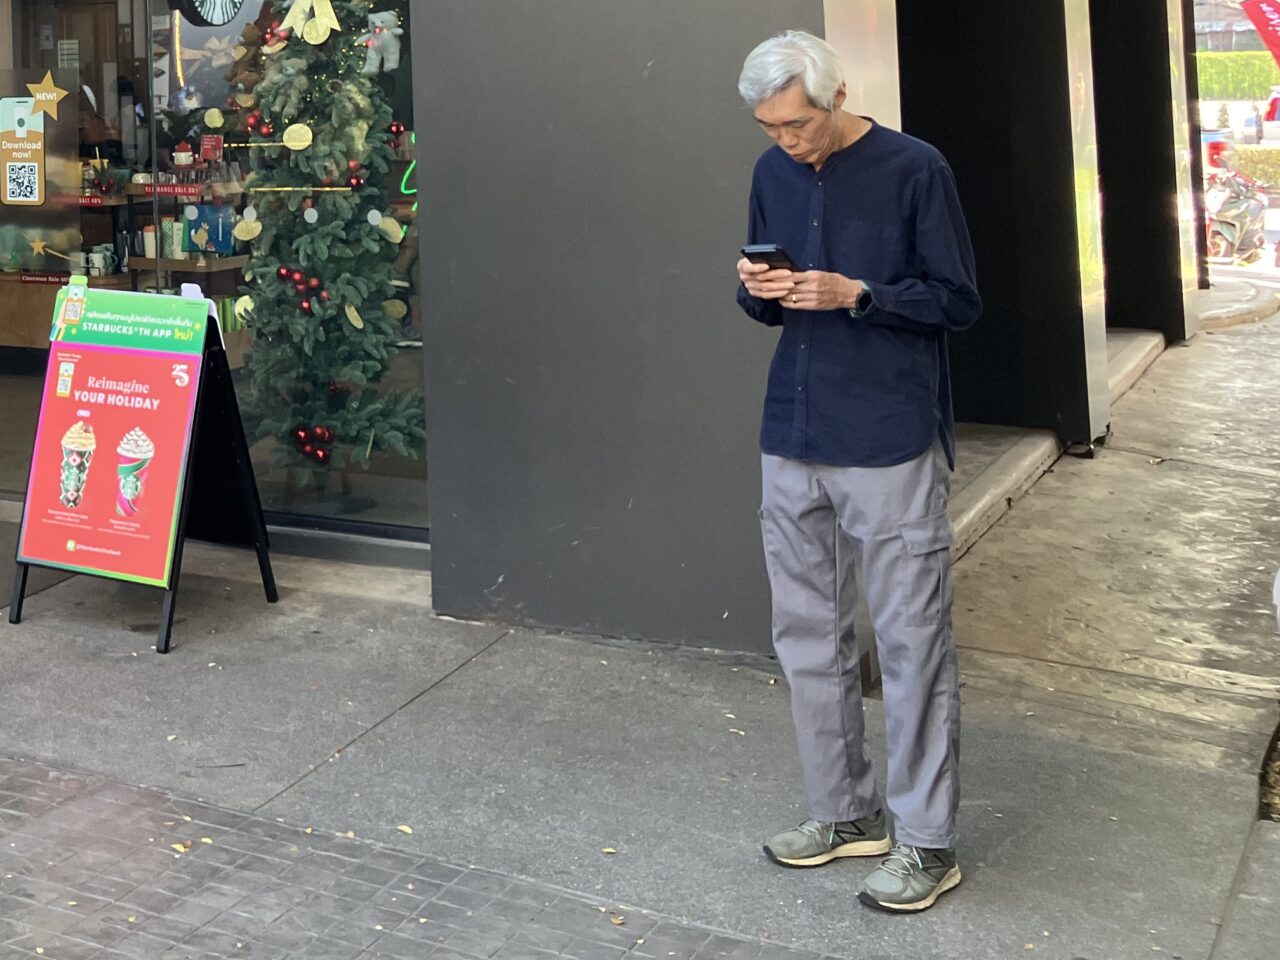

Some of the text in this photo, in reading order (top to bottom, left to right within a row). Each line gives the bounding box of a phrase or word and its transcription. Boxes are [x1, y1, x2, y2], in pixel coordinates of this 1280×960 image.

[35, 92, 57, 101] NEW!
[1, 140, 42, 149] Download
[12, 150, 32, 158] now!
[139, 326, 151, 337] TH
[152, 328, 172, 339] APP
[87, 375, 150, 394] Reimagine
[73, 389, 160, 411] YOUR HOLIDAY
